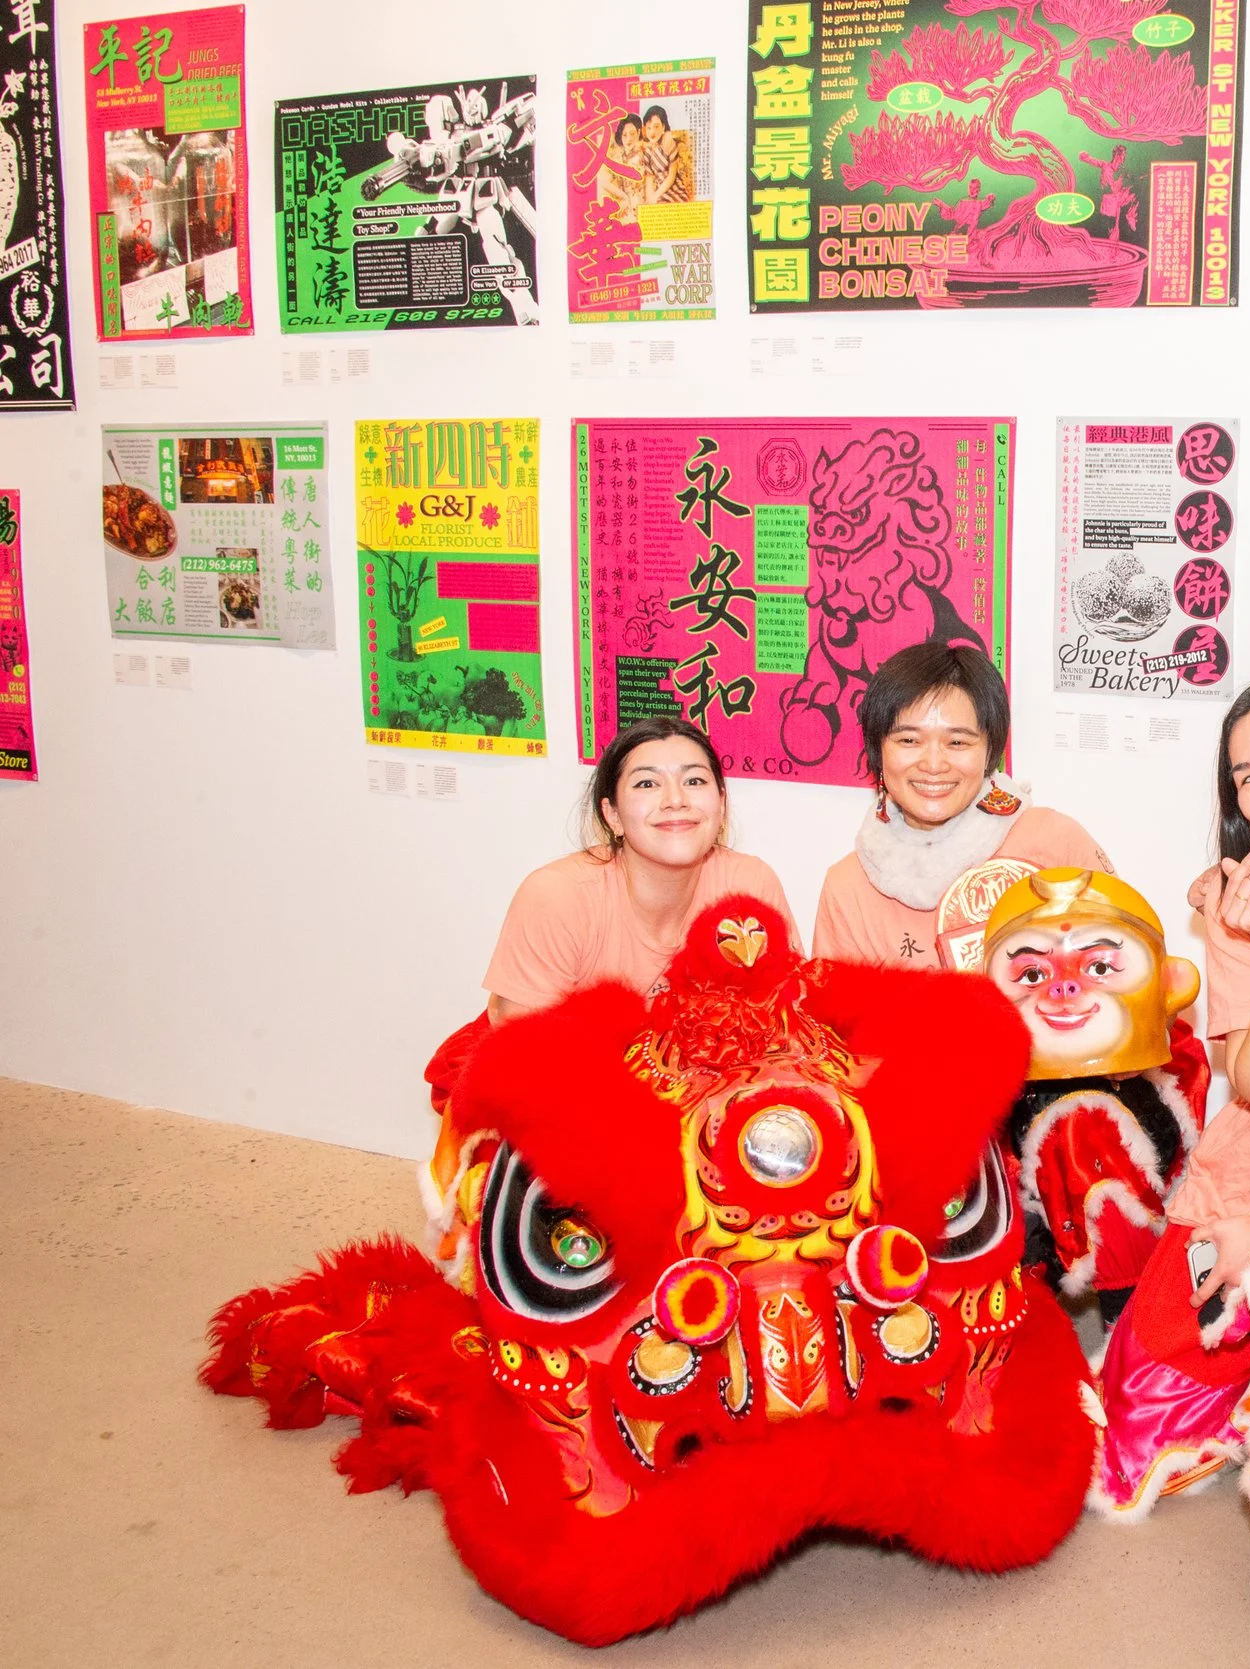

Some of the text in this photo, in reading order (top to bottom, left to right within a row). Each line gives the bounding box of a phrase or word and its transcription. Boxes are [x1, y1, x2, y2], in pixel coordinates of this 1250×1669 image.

[822, 10, 905, 25] he grows the plants
[90, 24, 183, 90] 平記
[187, 48, 219, 65] JUNGS
[821, 51, 855, 64] kung fu
[187, 66, 217, 80] DRIED
[821, 66, 852, 75] master
[630, 78, 706, 97] 服裝有限公司
[821, 77, 858, 88] and calls
[96, 99, 109, 108] New
[127, 96, 137, 105] NY
[137, 94, 158, 103] 10013
[821, 89, 854, 101] himself
[749, 2, 815, 303] 丹盆景花園
[35, 156, 44, 190] Trading
[377, 206, 405, 217] Friendly
[406, 202, 457, 215] Neighborhood
[819, 202, 932, 233] PEONY
[1047, 200, 1083, 218] 功夫
[671, 243, 711, 264] WEN
[819, 235, 969, 266] CHINESE
[670, 264, 712, 284] WAH
[590, 290, 612, 302] (646)
[613, 287, 629, 299] 919
[637, 281, 657, 293] 1321
[819, 268, 949, 299] BONSAI
[20, 270, 41, 321] 裕華
[665, 284, 713, 305] CORP
[288, 308, 503, 325] CALL 212 608 9728
[1088, 426, 1170, 443] 經典港風
[383, 421, 512, 490] 新四時
[514, 421, 538, 444] 新鮮
[997, 455, 1006, 506] CALL
[420, 494, 476, 522] G&J
[303, 476, 323, 593] 唐人街的
[420, 523, 474, 535] FLORIST
[394, 535, 503, 548] LOCAL PRODUCE
[182, 559, 254, 571] (212) 962-6475
[135, 564, 176, 592] 合利
[669, 436, 757, 735] 永安和
[1058, 634, 1149, 671] Sweets
[1145, 649, 1207, 673] (212) 219-2012
[618, 668, 667, 679] span their very
[1060, 667, 1093, 675] FOUNDED
[8, 682, 26, 694] (212)
[633, 680, 657, 688] custom
[1089, 666, 1180, 699] Bakery
[619, 690, 673, 700] porcelain pieces,
[619, 710, 652, 719] individual
[619, 721, 632, 729] and
[0, 752, 28, 768] Store
[900, 932, 926, 958] 永
